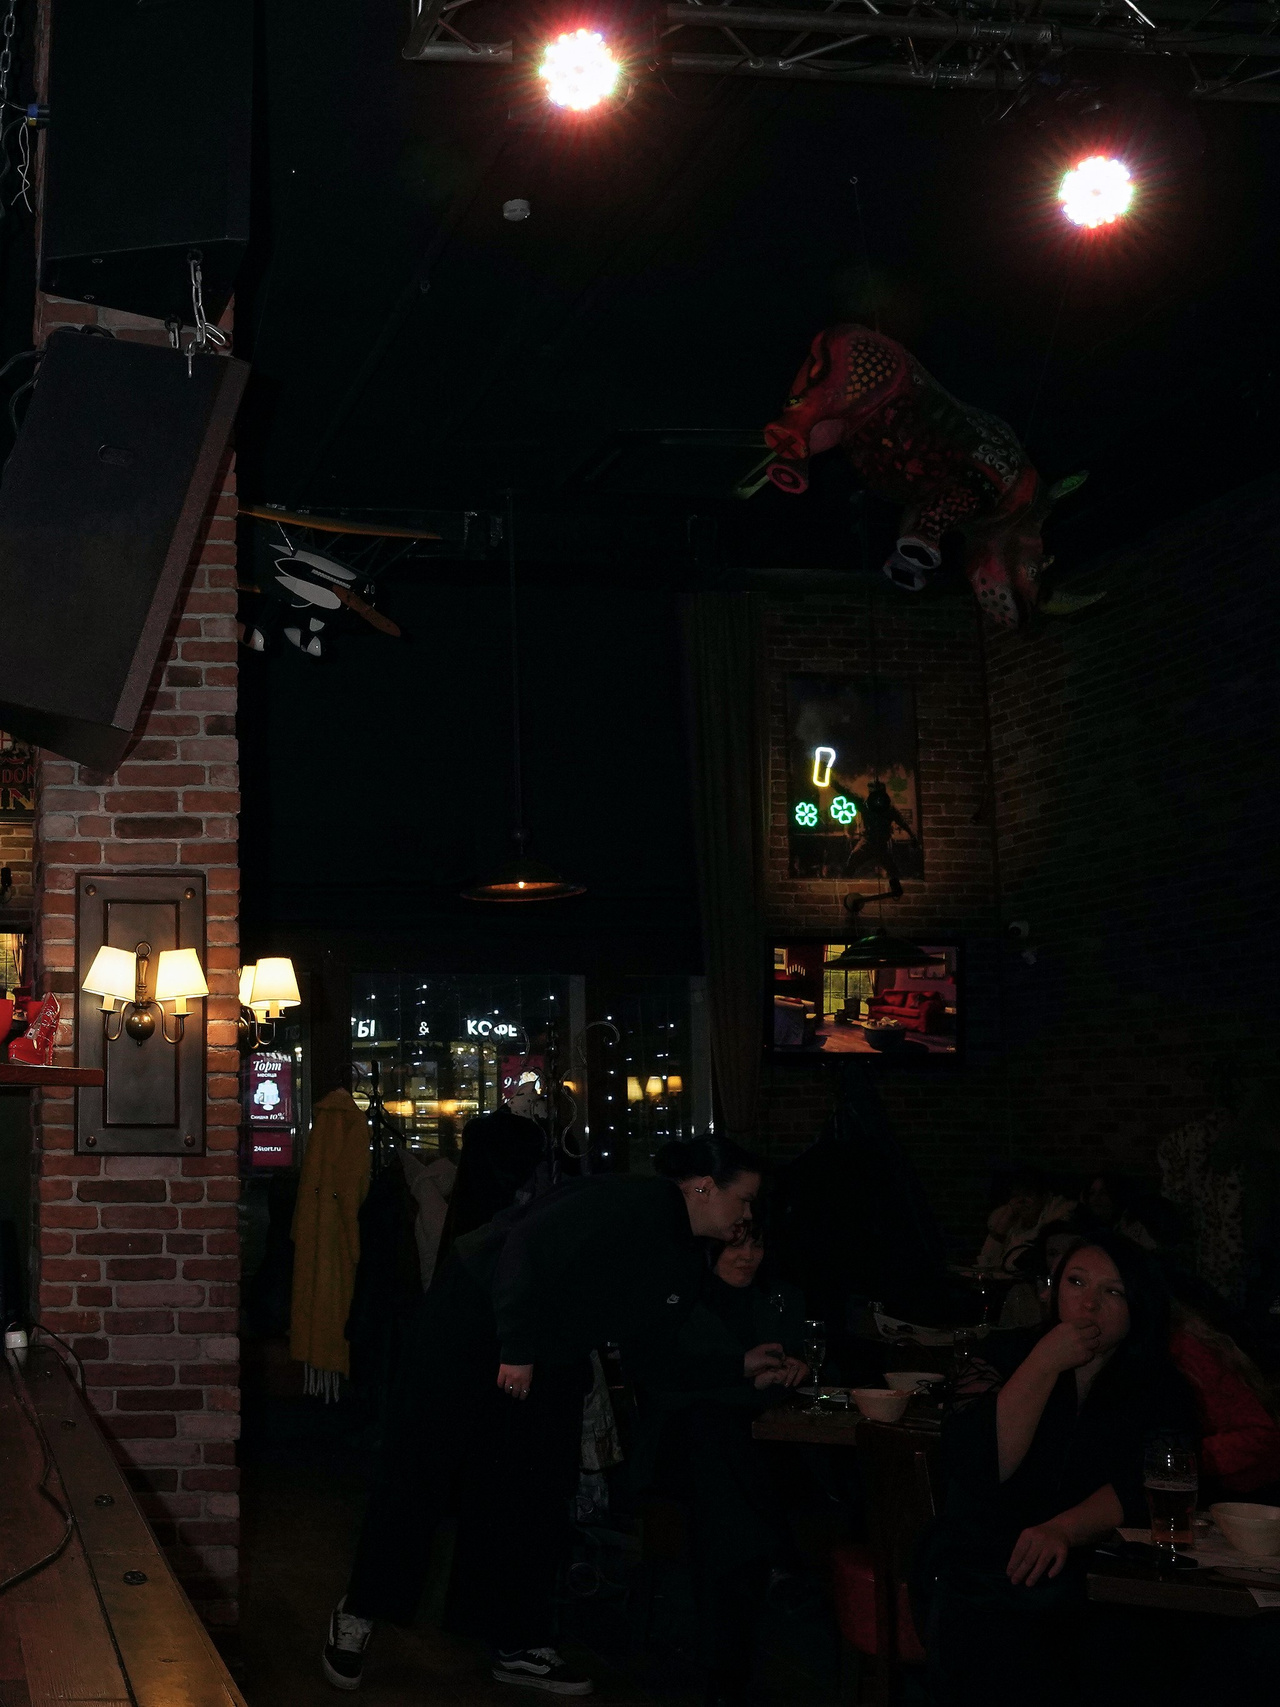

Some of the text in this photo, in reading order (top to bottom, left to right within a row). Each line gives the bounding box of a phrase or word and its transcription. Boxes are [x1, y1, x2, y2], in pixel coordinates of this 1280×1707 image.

[353, 1018, 518, 1038] Ы & КОФЕ
